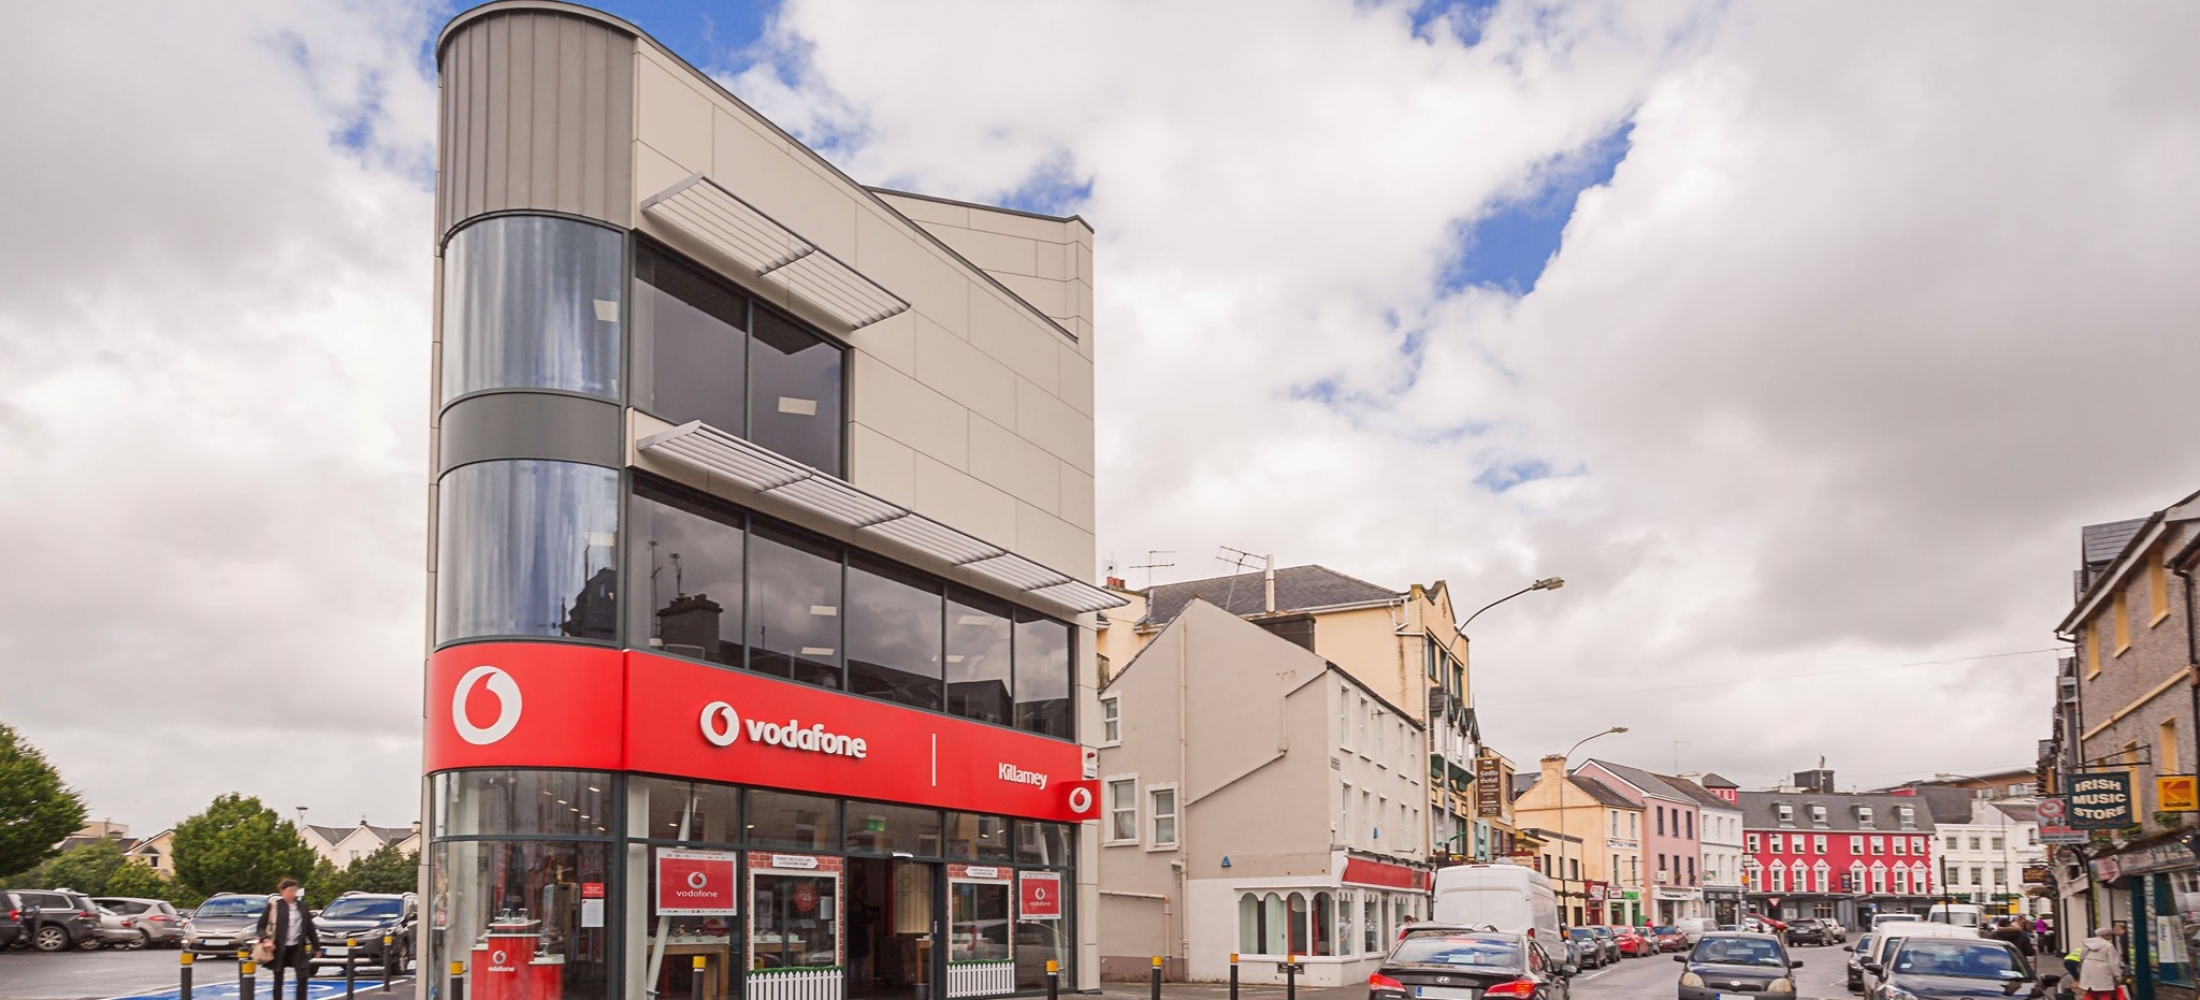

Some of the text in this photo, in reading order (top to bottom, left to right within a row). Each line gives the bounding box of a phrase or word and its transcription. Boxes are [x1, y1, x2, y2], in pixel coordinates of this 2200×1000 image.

[745, 719, 867, 758] vodafone
[998, 762, 1048, 790] Killarney
[2074, 779, 2122, 793] IRISH
[2072, 793, 2127, 805] MUSIC
[2073, 805, 2126, 820] STORE
[676, 889, 718, 898] vodafone
